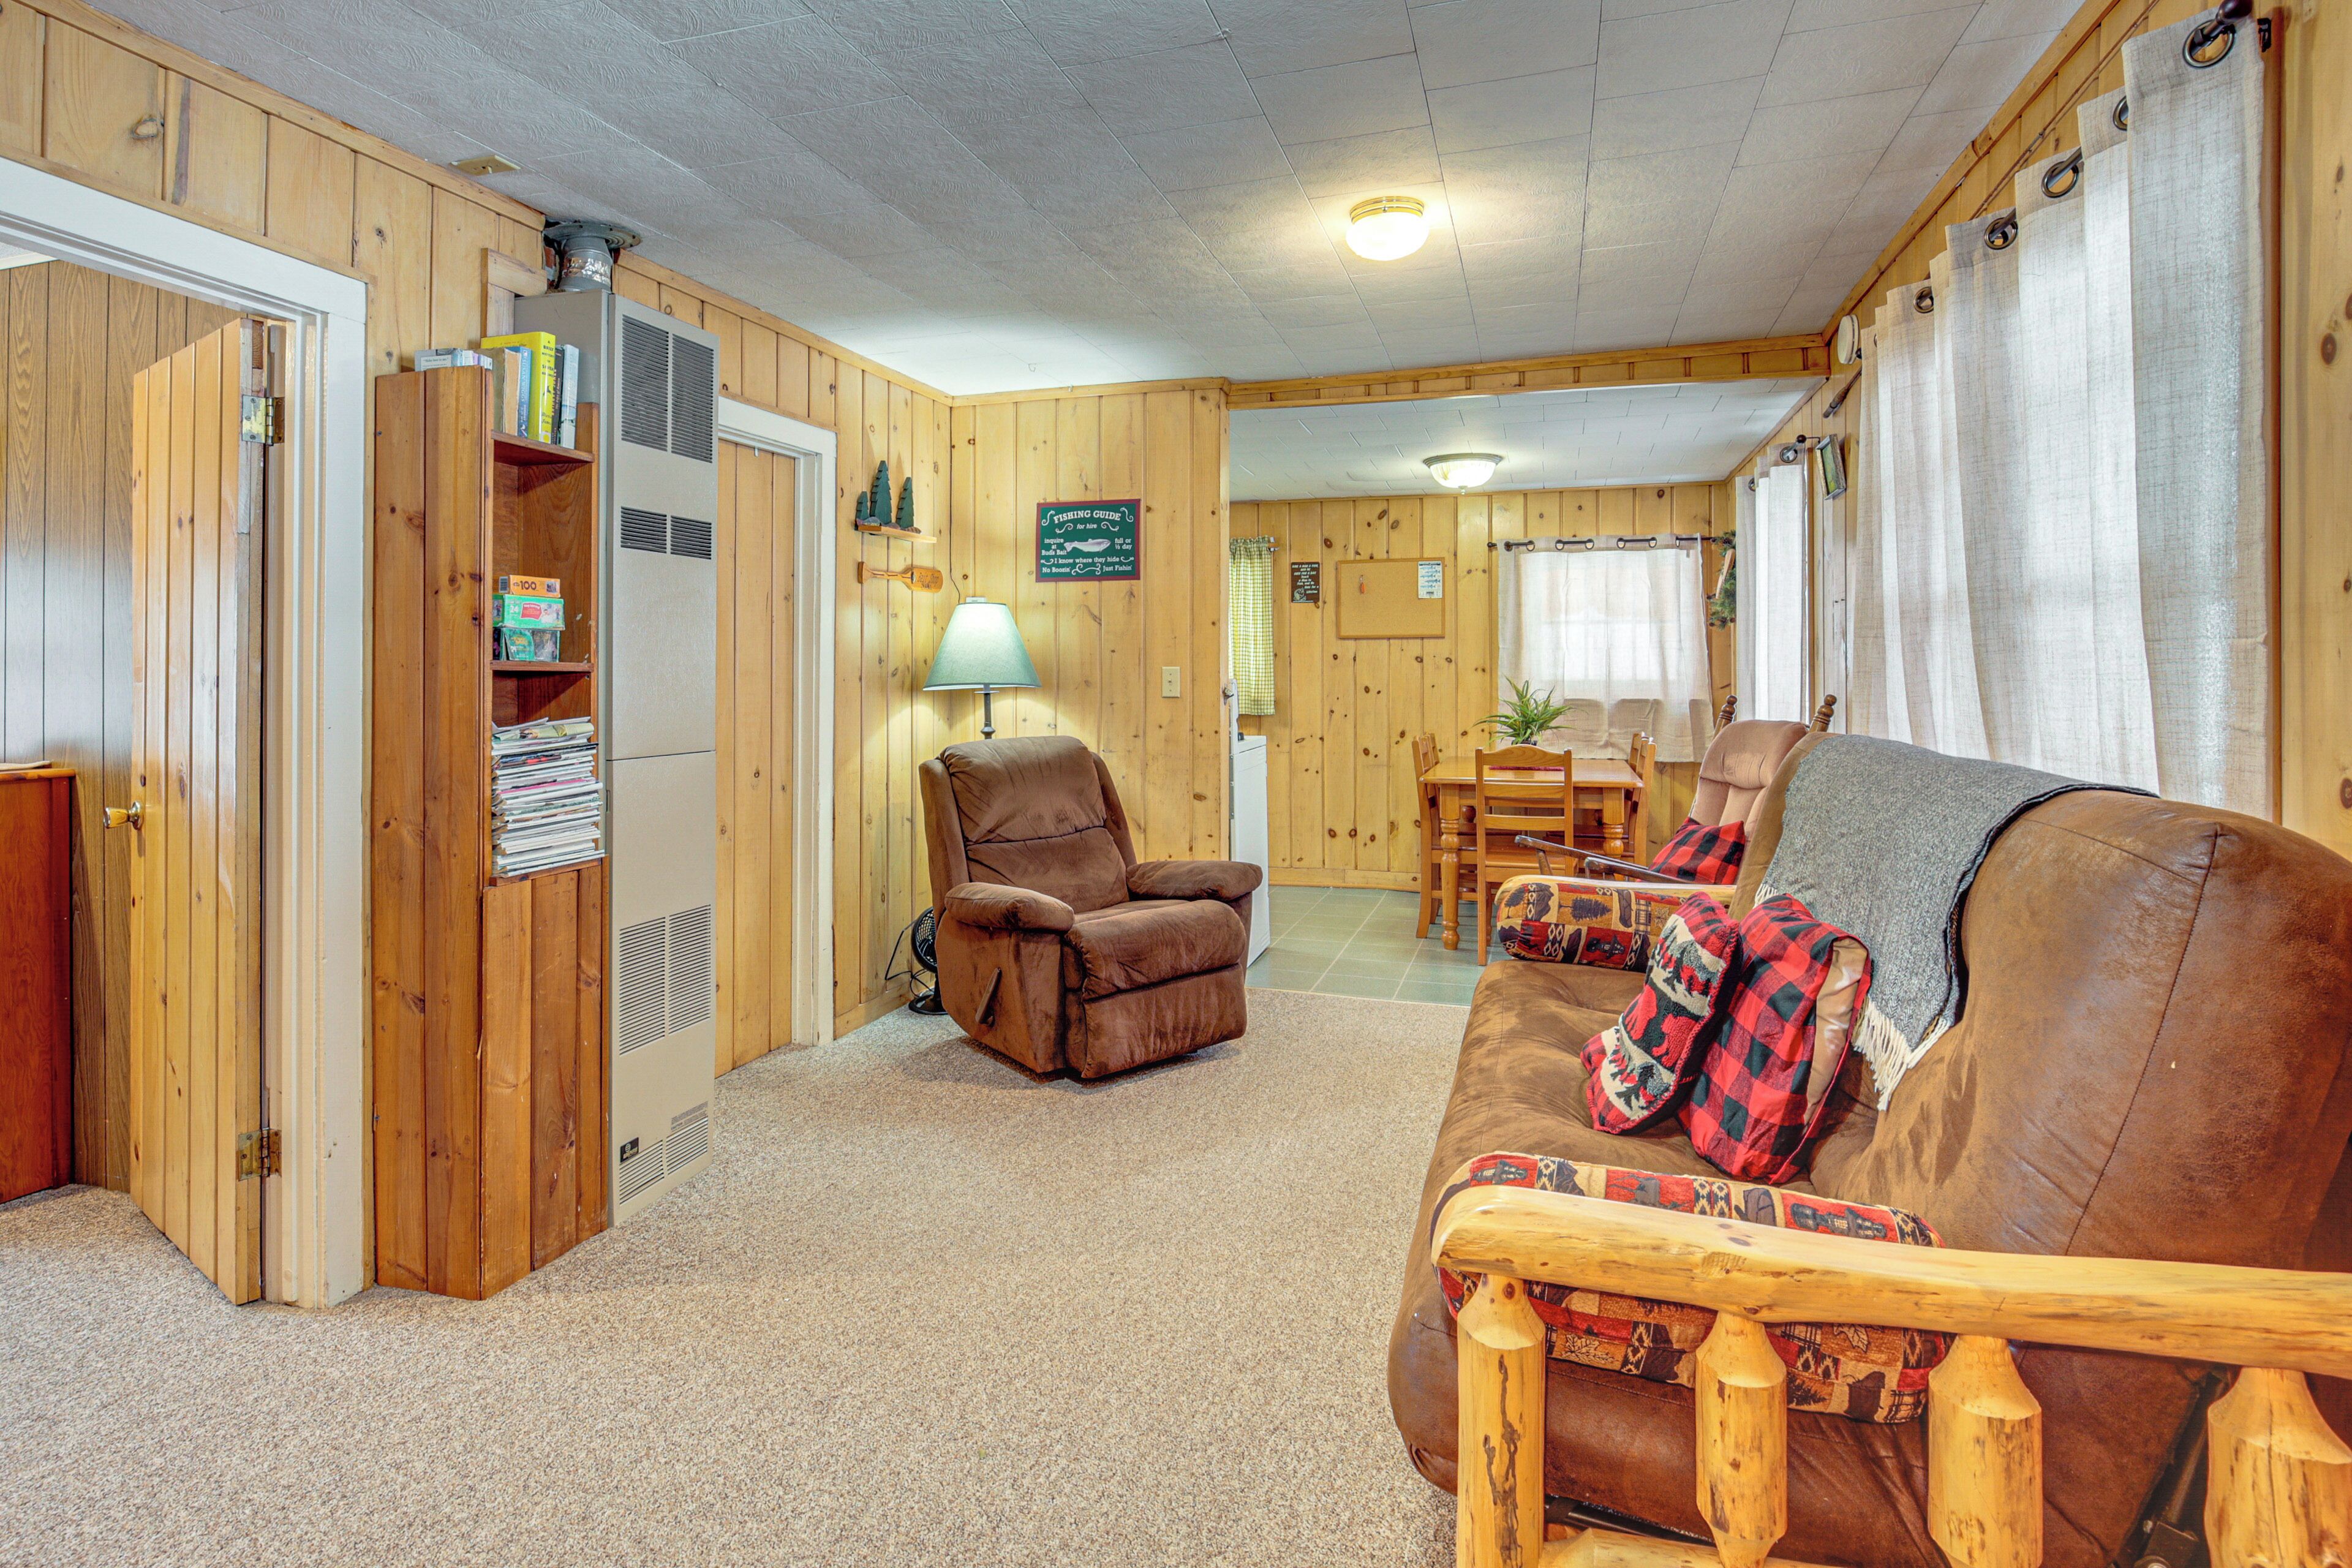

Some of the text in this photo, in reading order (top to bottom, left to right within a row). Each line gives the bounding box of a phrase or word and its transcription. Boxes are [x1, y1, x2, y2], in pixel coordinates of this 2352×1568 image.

[1054, 510, 1121, 524] FISHING GUIDE
[519, 581, 537, 590] 100
